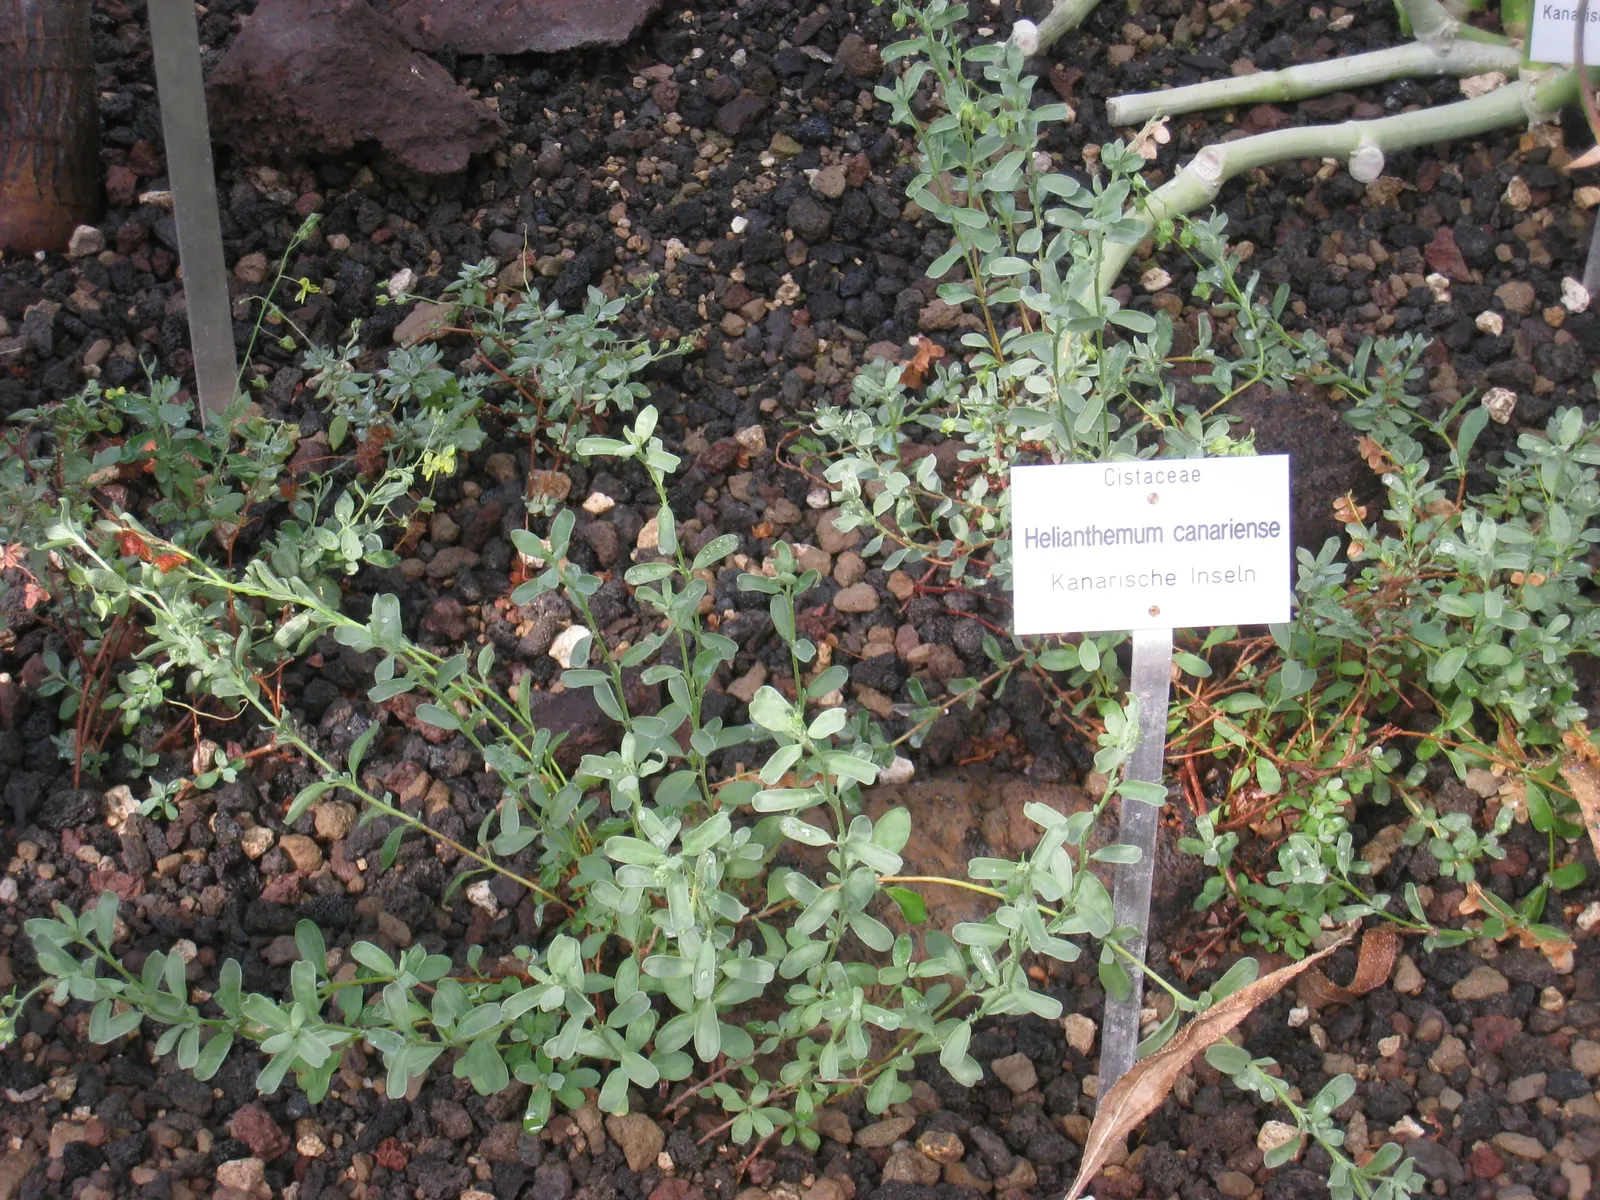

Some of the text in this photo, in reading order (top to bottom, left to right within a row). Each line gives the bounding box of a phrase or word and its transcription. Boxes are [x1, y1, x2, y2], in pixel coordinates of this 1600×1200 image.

[1543, 4, 1600, 22] Kanais
[1104, 468, 1201, 486] Cistaceae
[1024, 518, 1281, 549] Helianthemum canariense
[1051, 565, 1256, 591] Kanarische Inseln
